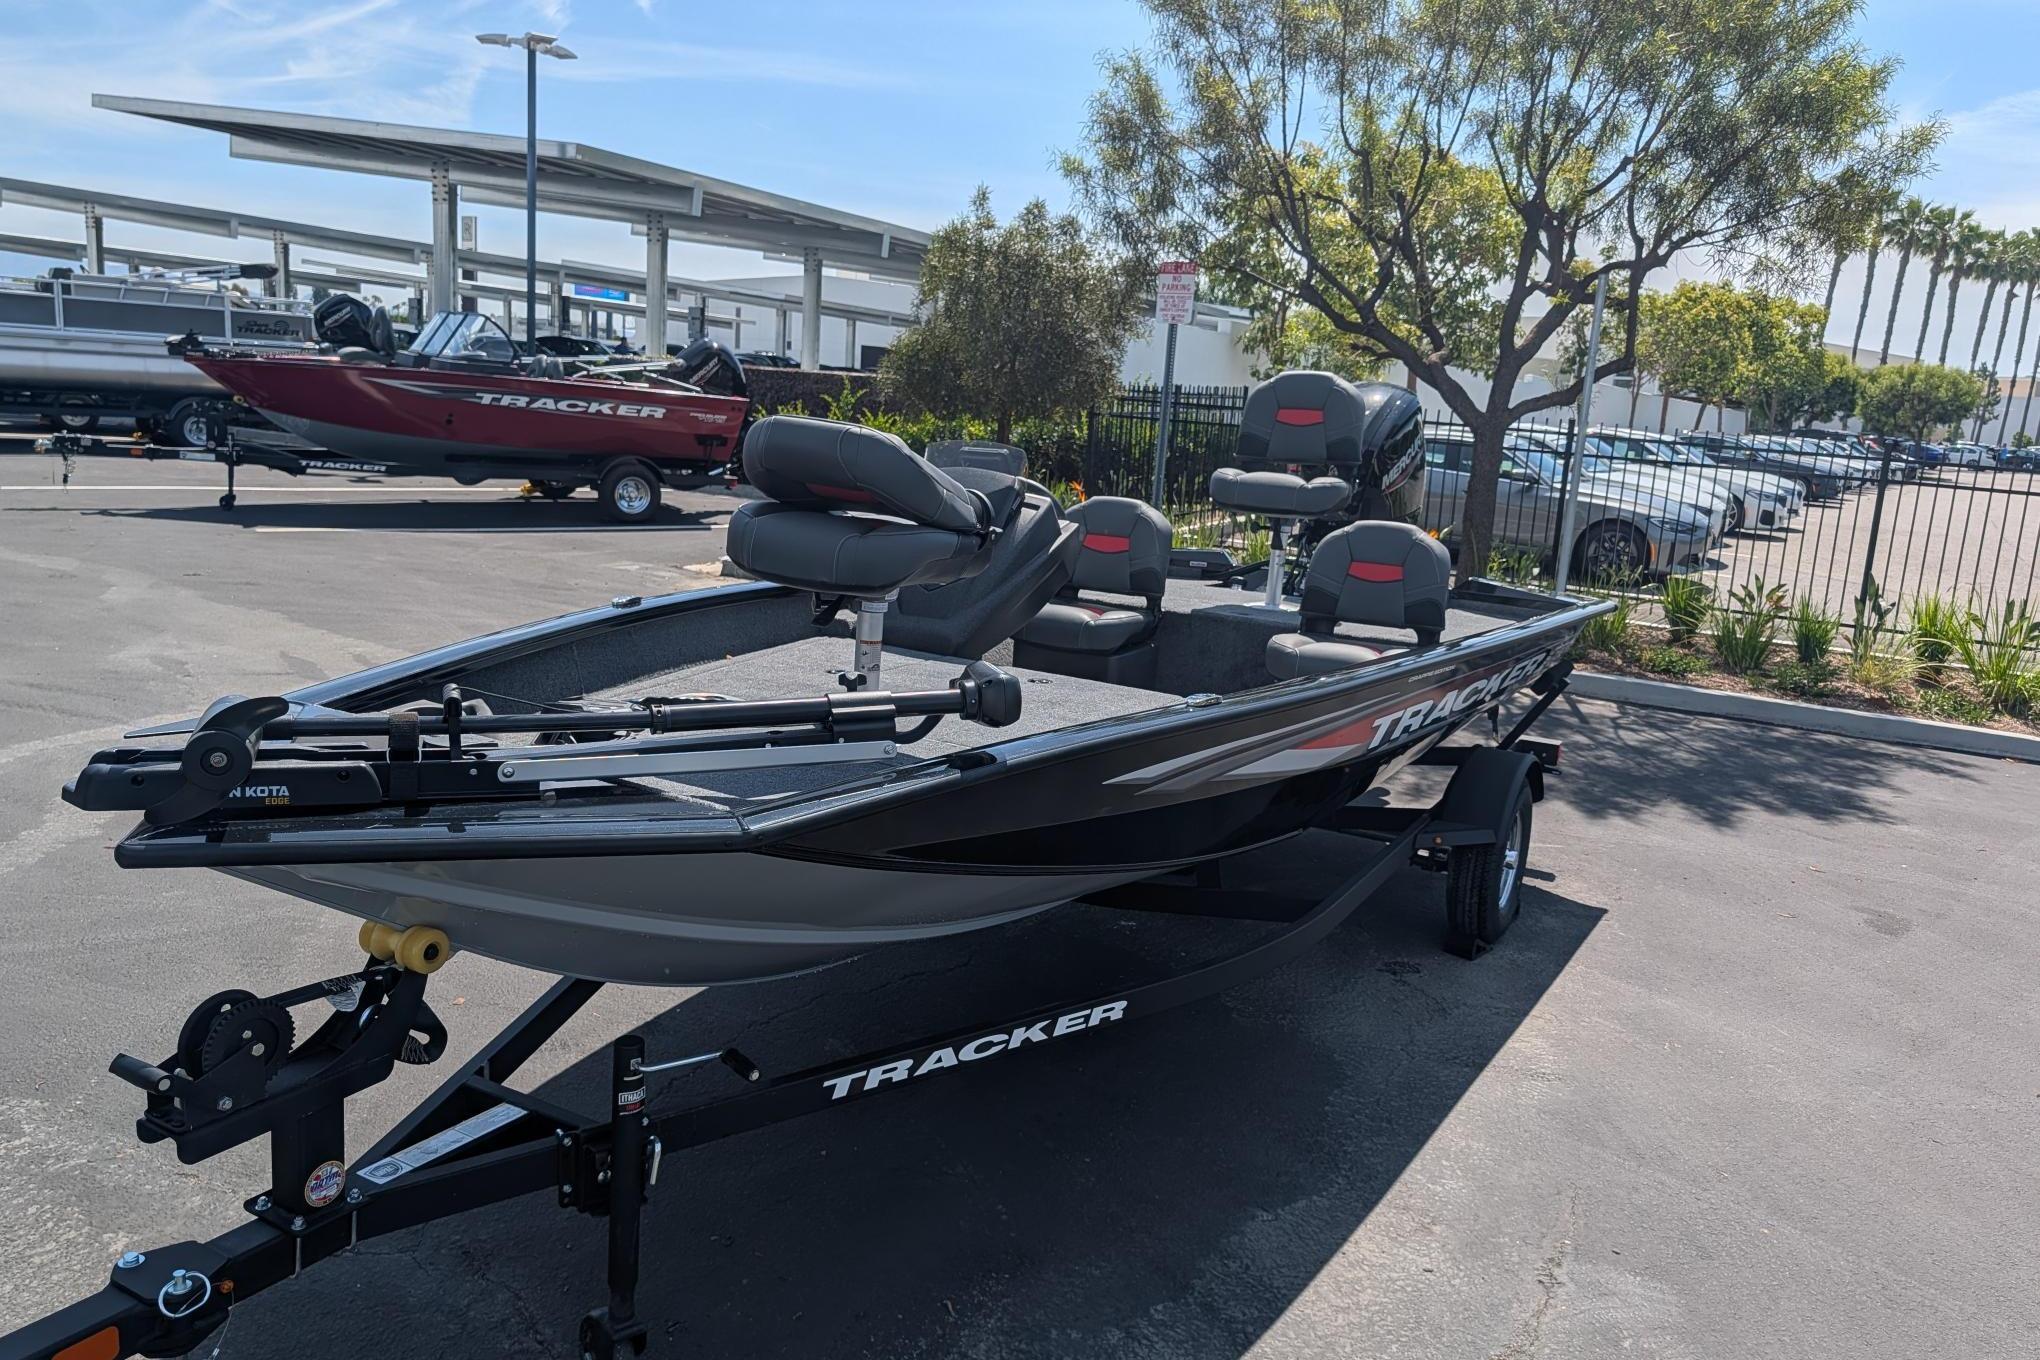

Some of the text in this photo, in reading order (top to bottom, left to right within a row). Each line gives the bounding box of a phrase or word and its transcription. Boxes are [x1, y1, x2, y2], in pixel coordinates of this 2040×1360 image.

[1172, 275, 1182, 283] NO
[1161, 283, 1191, 292] PARKING
[236, 325, 300, 337] TRACKER
[690, 356, 719, 384] MERCURY
[475, 391, 667, 419] TRACKER
[298, 459, 388, 472] TRACKER
[1367, 652, 1548, 750] TRACKER
[245, 785, 290, 797] KOTA
[265, 797, 290, 805] EDGE
[822, 999, 1129, 1101] TRACKER
